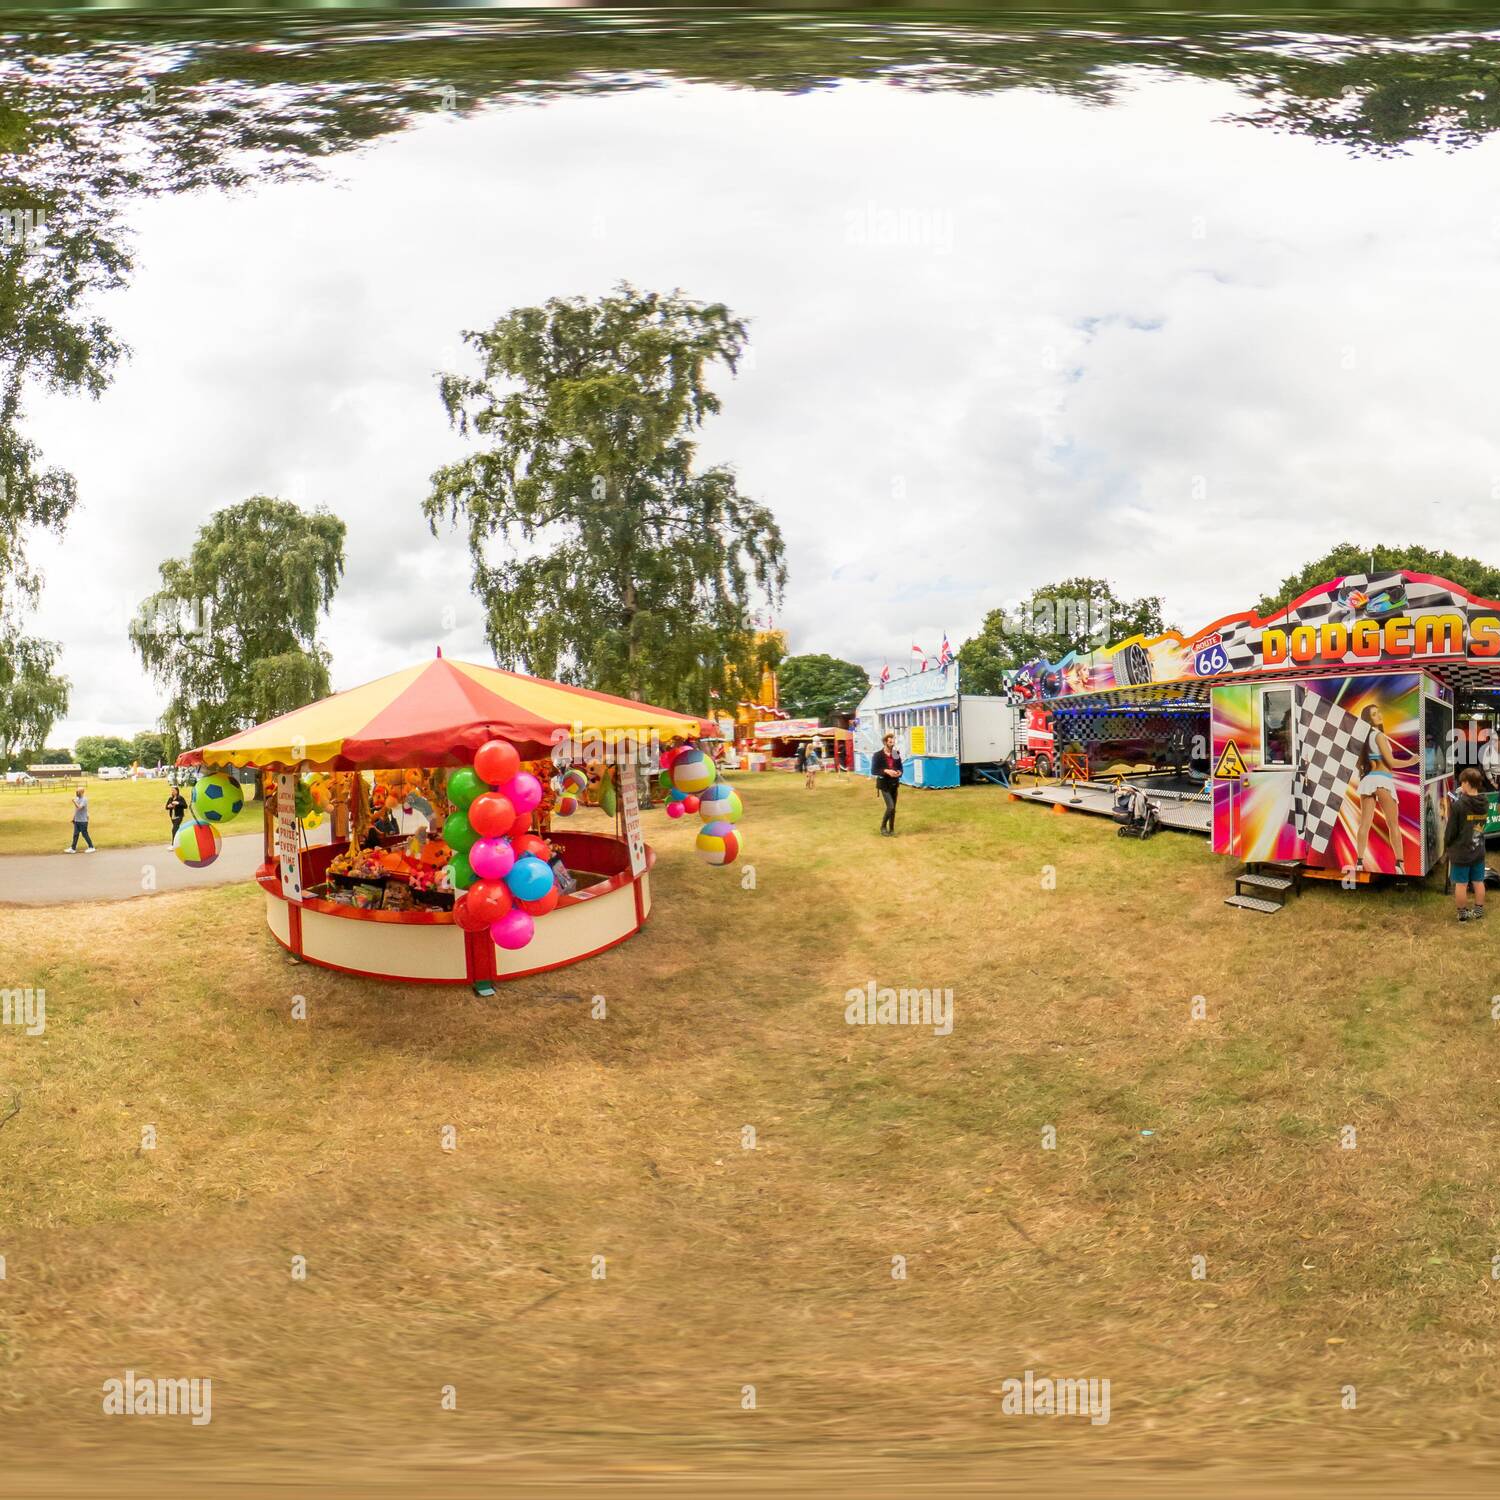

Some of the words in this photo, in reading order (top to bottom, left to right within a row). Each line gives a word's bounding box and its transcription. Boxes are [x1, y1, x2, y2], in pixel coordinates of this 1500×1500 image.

[1195, 635, 1218, 650] ROUTE
[1199, 648, 1224, 674] 66
[280, 827, 296, 840] PRIZE
[280, 841, 296, 853] EVERY
[283, 854, 296, 867] TIME
